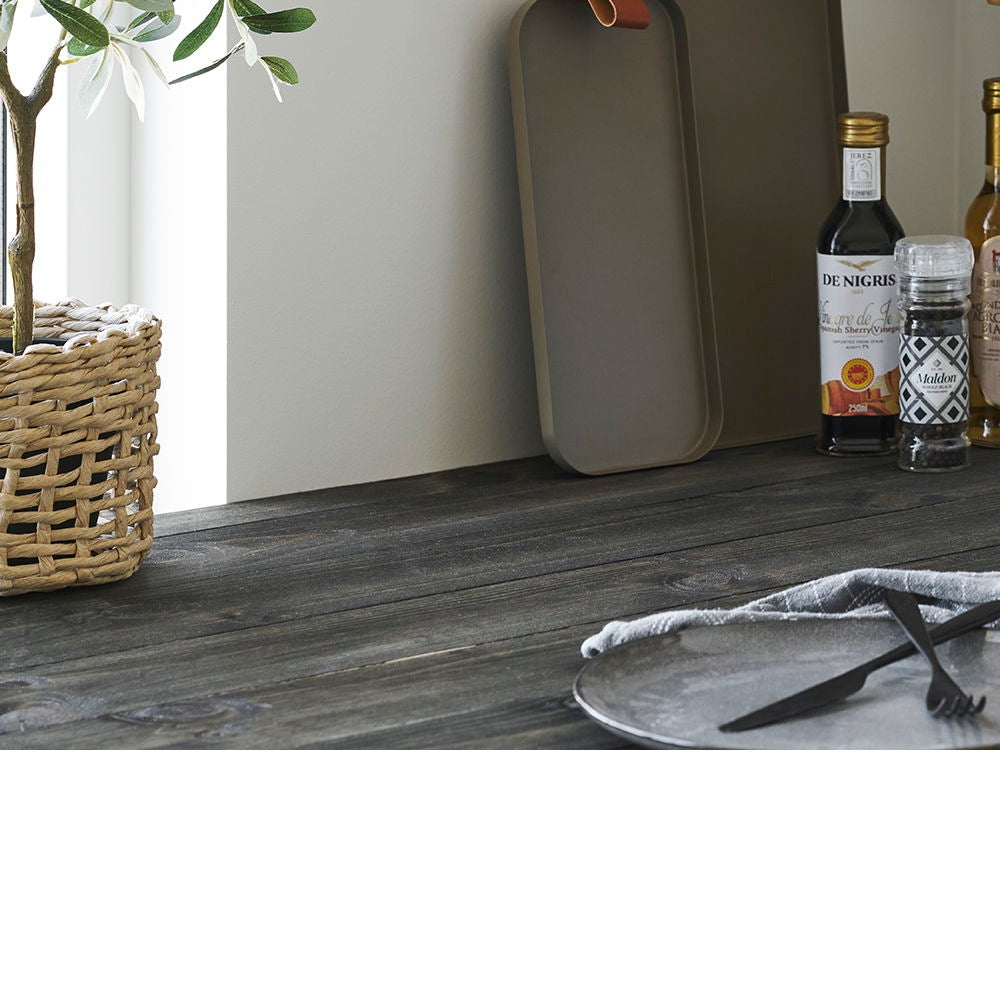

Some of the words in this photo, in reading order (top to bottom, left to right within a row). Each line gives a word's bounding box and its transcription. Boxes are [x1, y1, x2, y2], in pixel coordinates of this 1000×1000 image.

[823, 273, 840, 287] DE
[843, 274, 896, 287] NIGRIS
[856, 301, 875, 326] de
[844, 325, 873, 336] Sherry
[918, 373, 957, 384] Maldon
